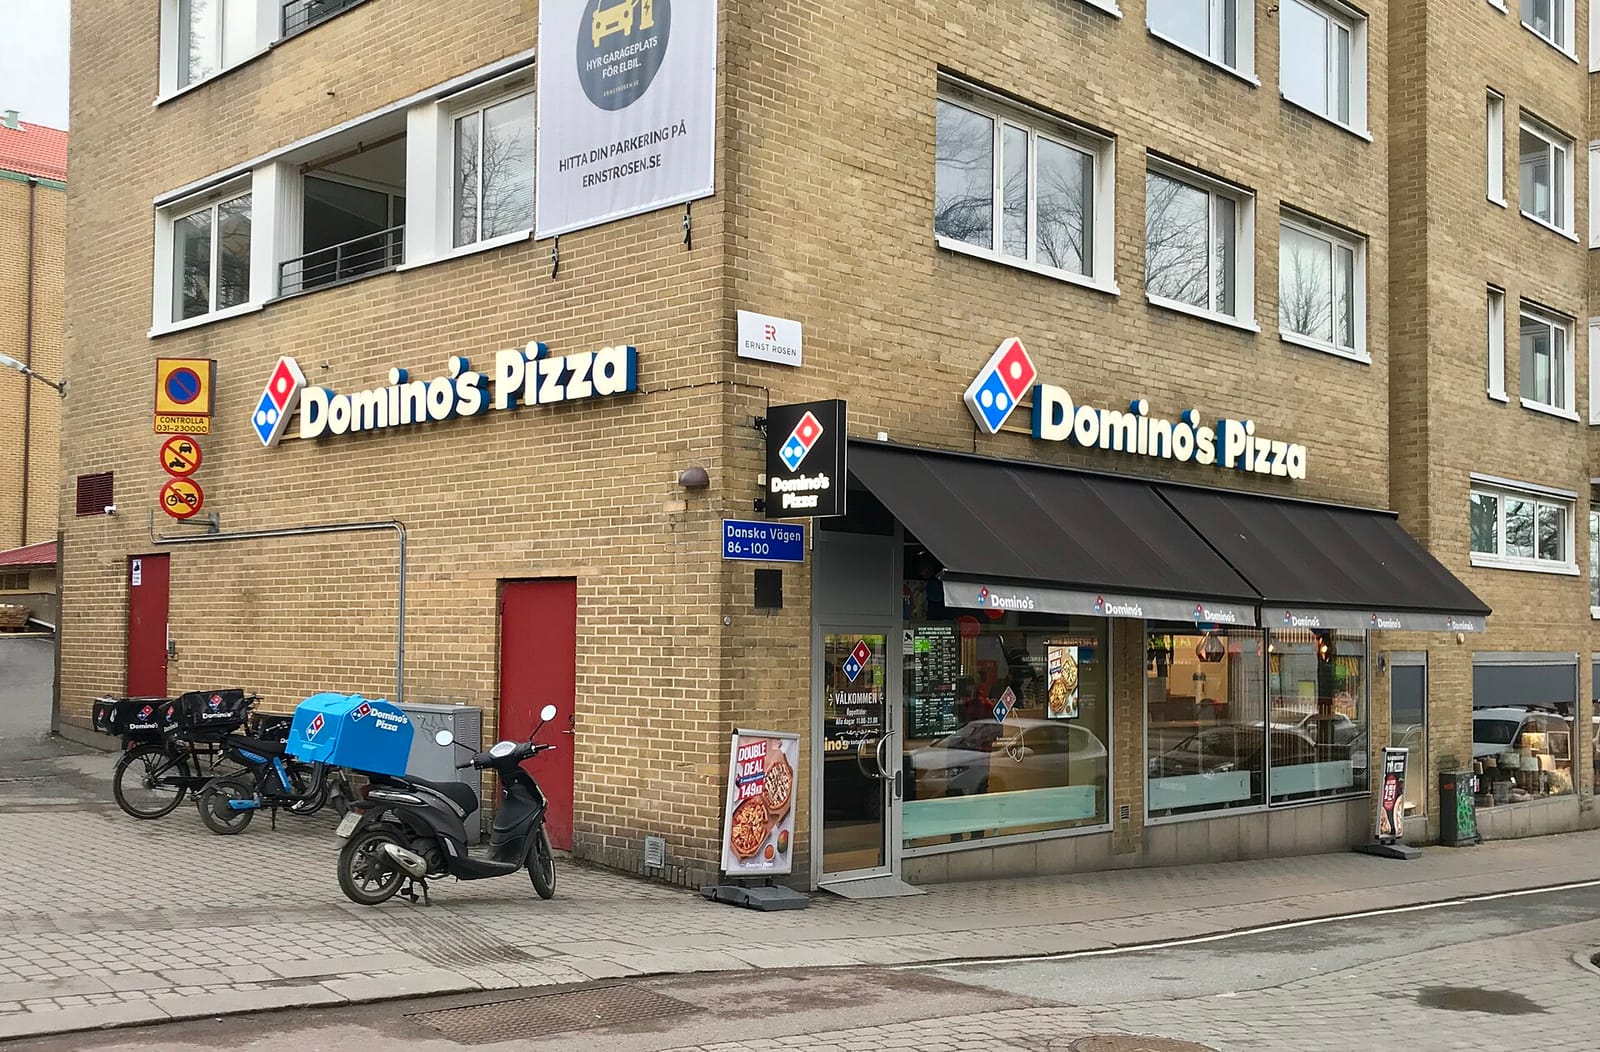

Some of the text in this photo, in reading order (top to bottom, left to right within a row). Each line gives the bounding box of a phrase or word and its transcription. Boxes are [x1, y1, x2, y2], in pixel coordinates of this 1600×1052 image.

[586, 36, 658, 71] HYR GARAGEPLATS
[603, 58, 642, 79] FÖR ELBIL.
[559, 119, 687, 173] HITTA DIN PARKERING PÅ
[582, 154, 662, 188] ERNSTROSEN.SE
[745, 340, 797, 357] ERNST ROSEN
[300, 340, 635, 440] Domino's Pizza
[156, 424, 208, 433] 031-230000
[160, 416, 205, 425] CONTROLLA
[1034, 383, 1307, 480] Domino's Pizza
[771, 472, 830, 493] Domino's
[782, 492, 819, 509] Pizza
[727, 525, 801, 543] Danska Vägen
[991, 593, 1034, 610] Domino's
[1105, 602, 1143, 617] Domino's
[1204, 610, 1236, 623] Domino's
[1291, 615, 1320, 628] Domino's
[1377, 617, 1402, 629] Domino's
[835, 690, 878, 705] VÄLKOMMEN
[370, 707, 408, 724] Domino's
[375, 719, 399, 732] Pizza
[738, 742, 767, 762] DOUBLE
[824, 736, 849, 752] ino's
[743, 759, 764, 777] DEAL
